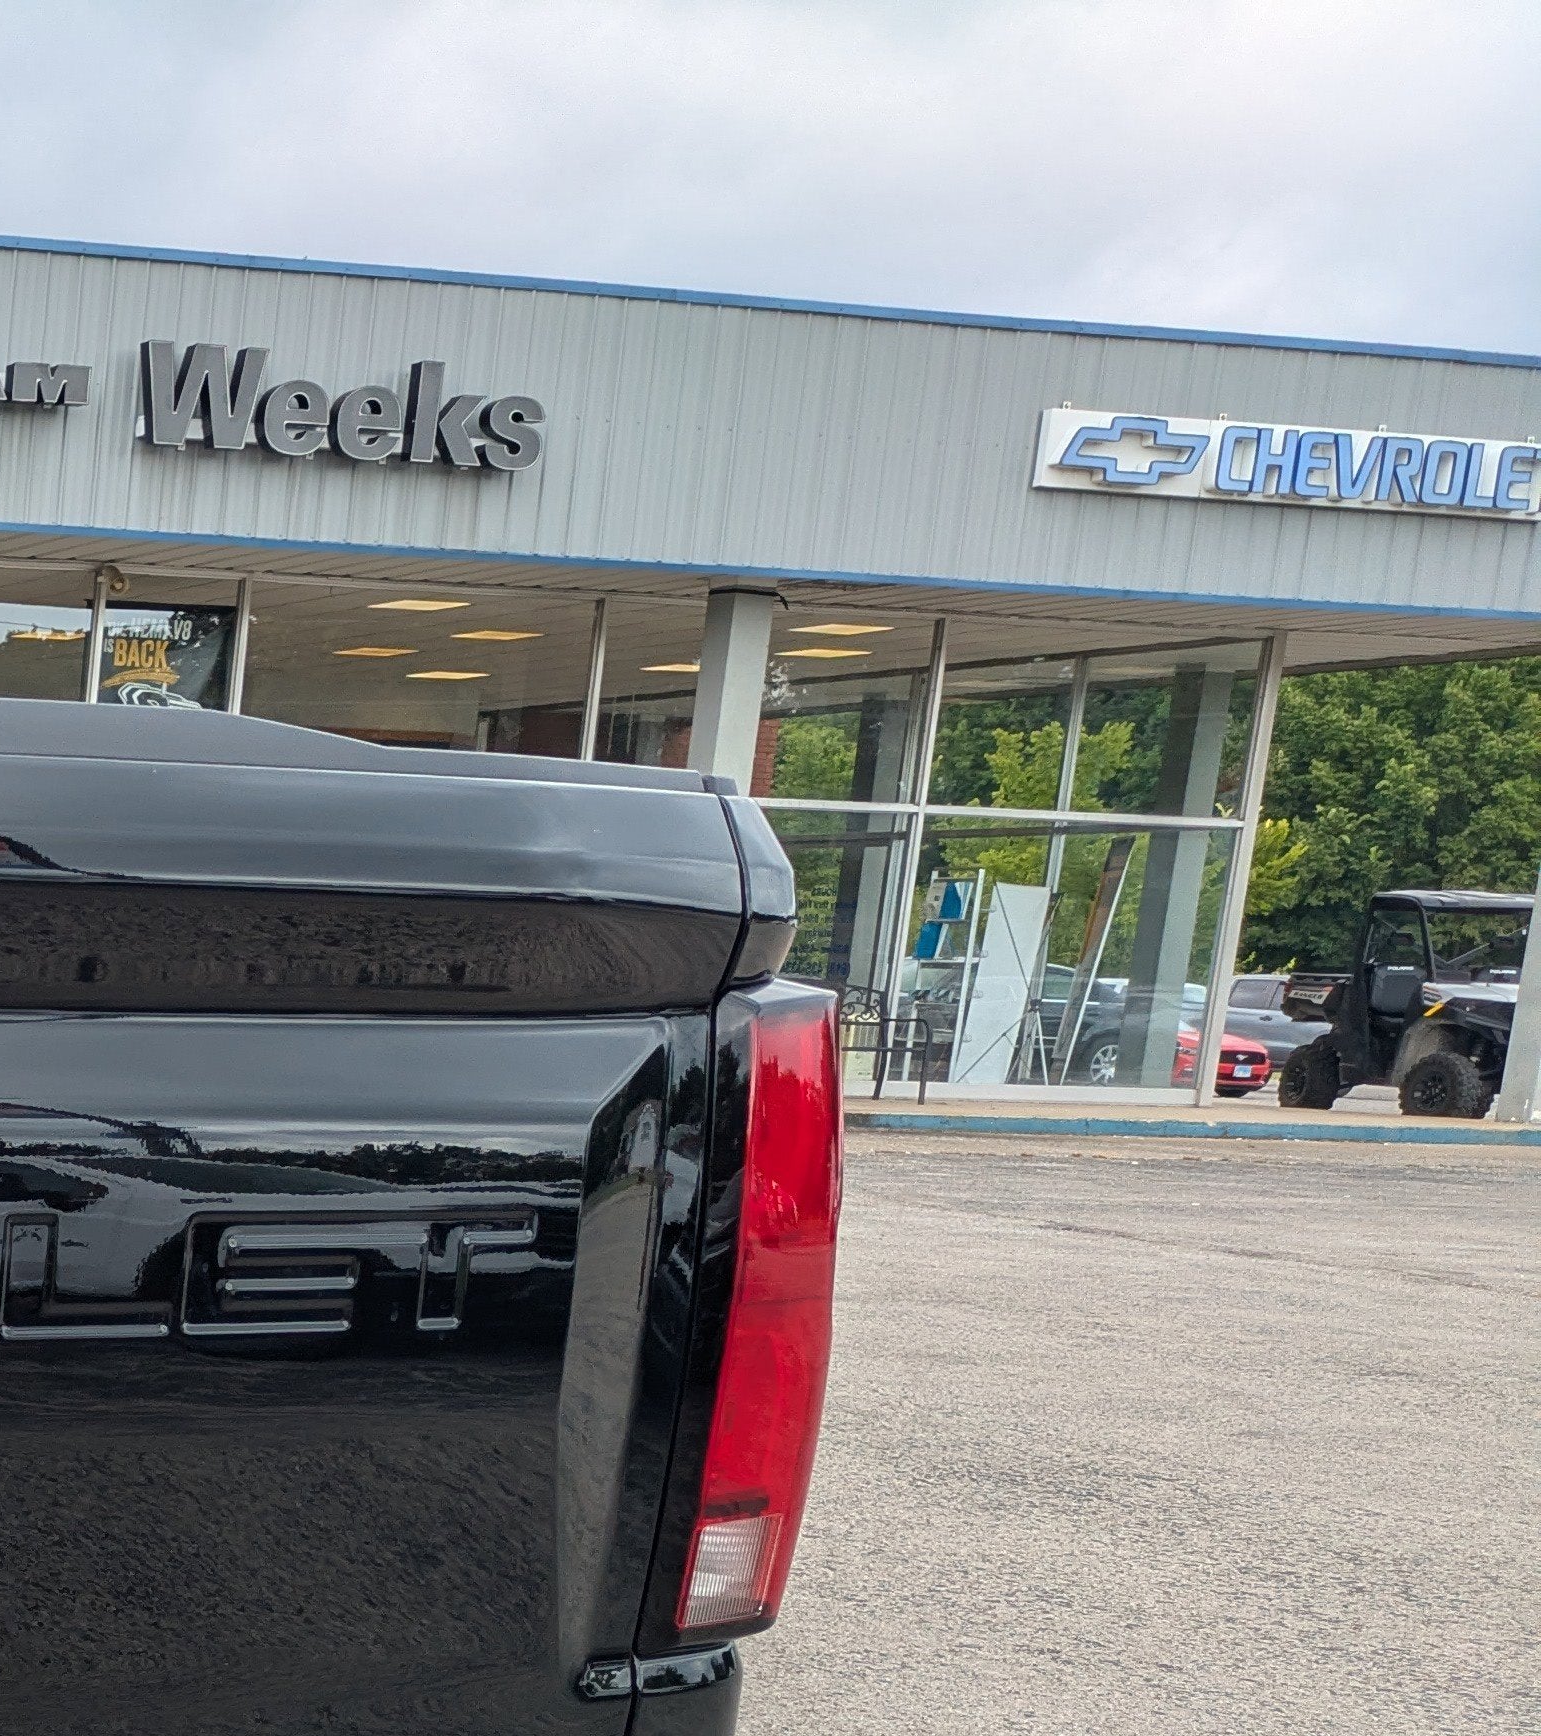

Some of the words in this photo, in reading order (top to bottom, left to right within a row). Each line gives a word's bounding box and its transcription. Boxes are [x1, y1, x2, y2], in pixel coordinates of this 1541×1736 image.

[139, 340, 546, 471] Weeks
[1216, 425, 1541, 511] CHEVROLE
[113, 638, 169, 669] BACK
[173, 619, 193, 641] V8
